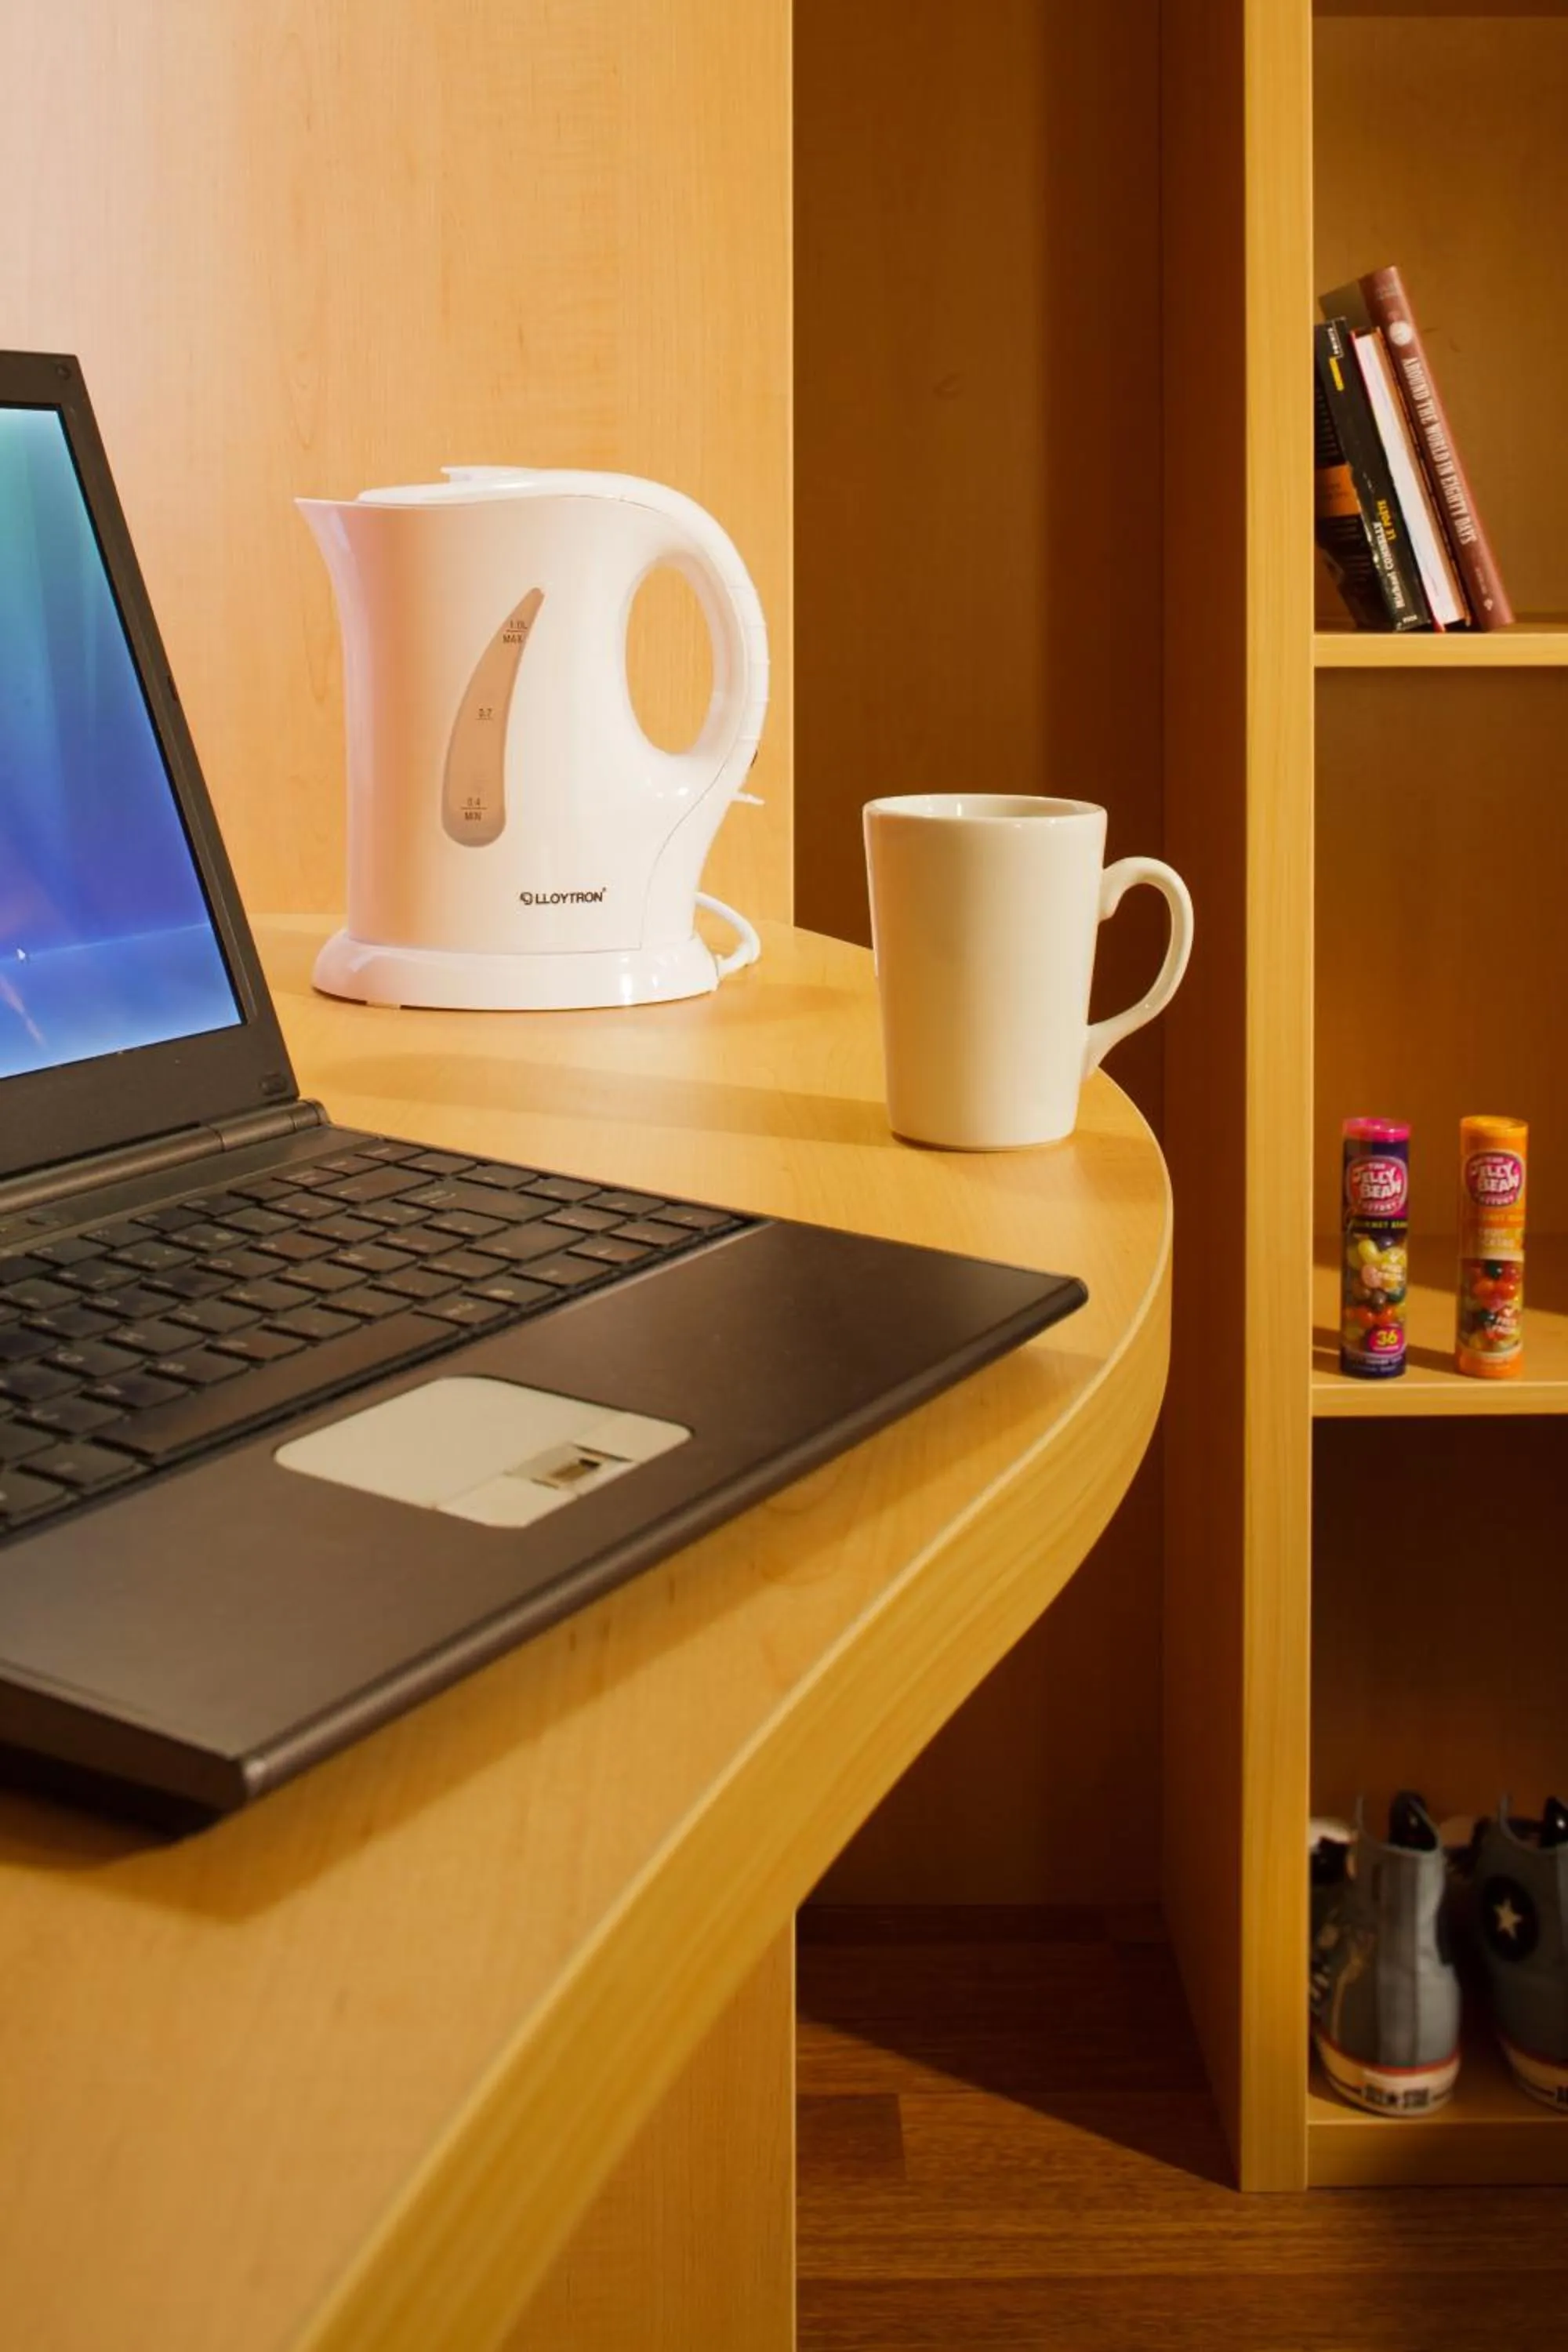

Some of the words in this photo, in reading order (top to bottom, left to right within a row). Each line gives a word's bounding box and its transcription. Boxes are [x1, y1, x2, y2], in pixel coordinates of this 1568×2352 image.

[1403, 358, 1430, 401] AROUND
[1417, 401, 1438, 426] THE
[1425, 423, 1450, 462] WORLD
[1436, 460, 1455, 478] IN
[1441, 476, 1469, 517] EIGHTY
[1454, 516, 1477, 545] DAYS
[503, 633, 524, 644] MAX
[465, 811, 482, 822] MIN
[535, 891, 603, 904] LLOYTRON
[1360, 1181, 1402, 1199] BEAN
[1478, 1175, 1519, 1192] BEAN
[1376, 1330, 1399, 1346] 36
